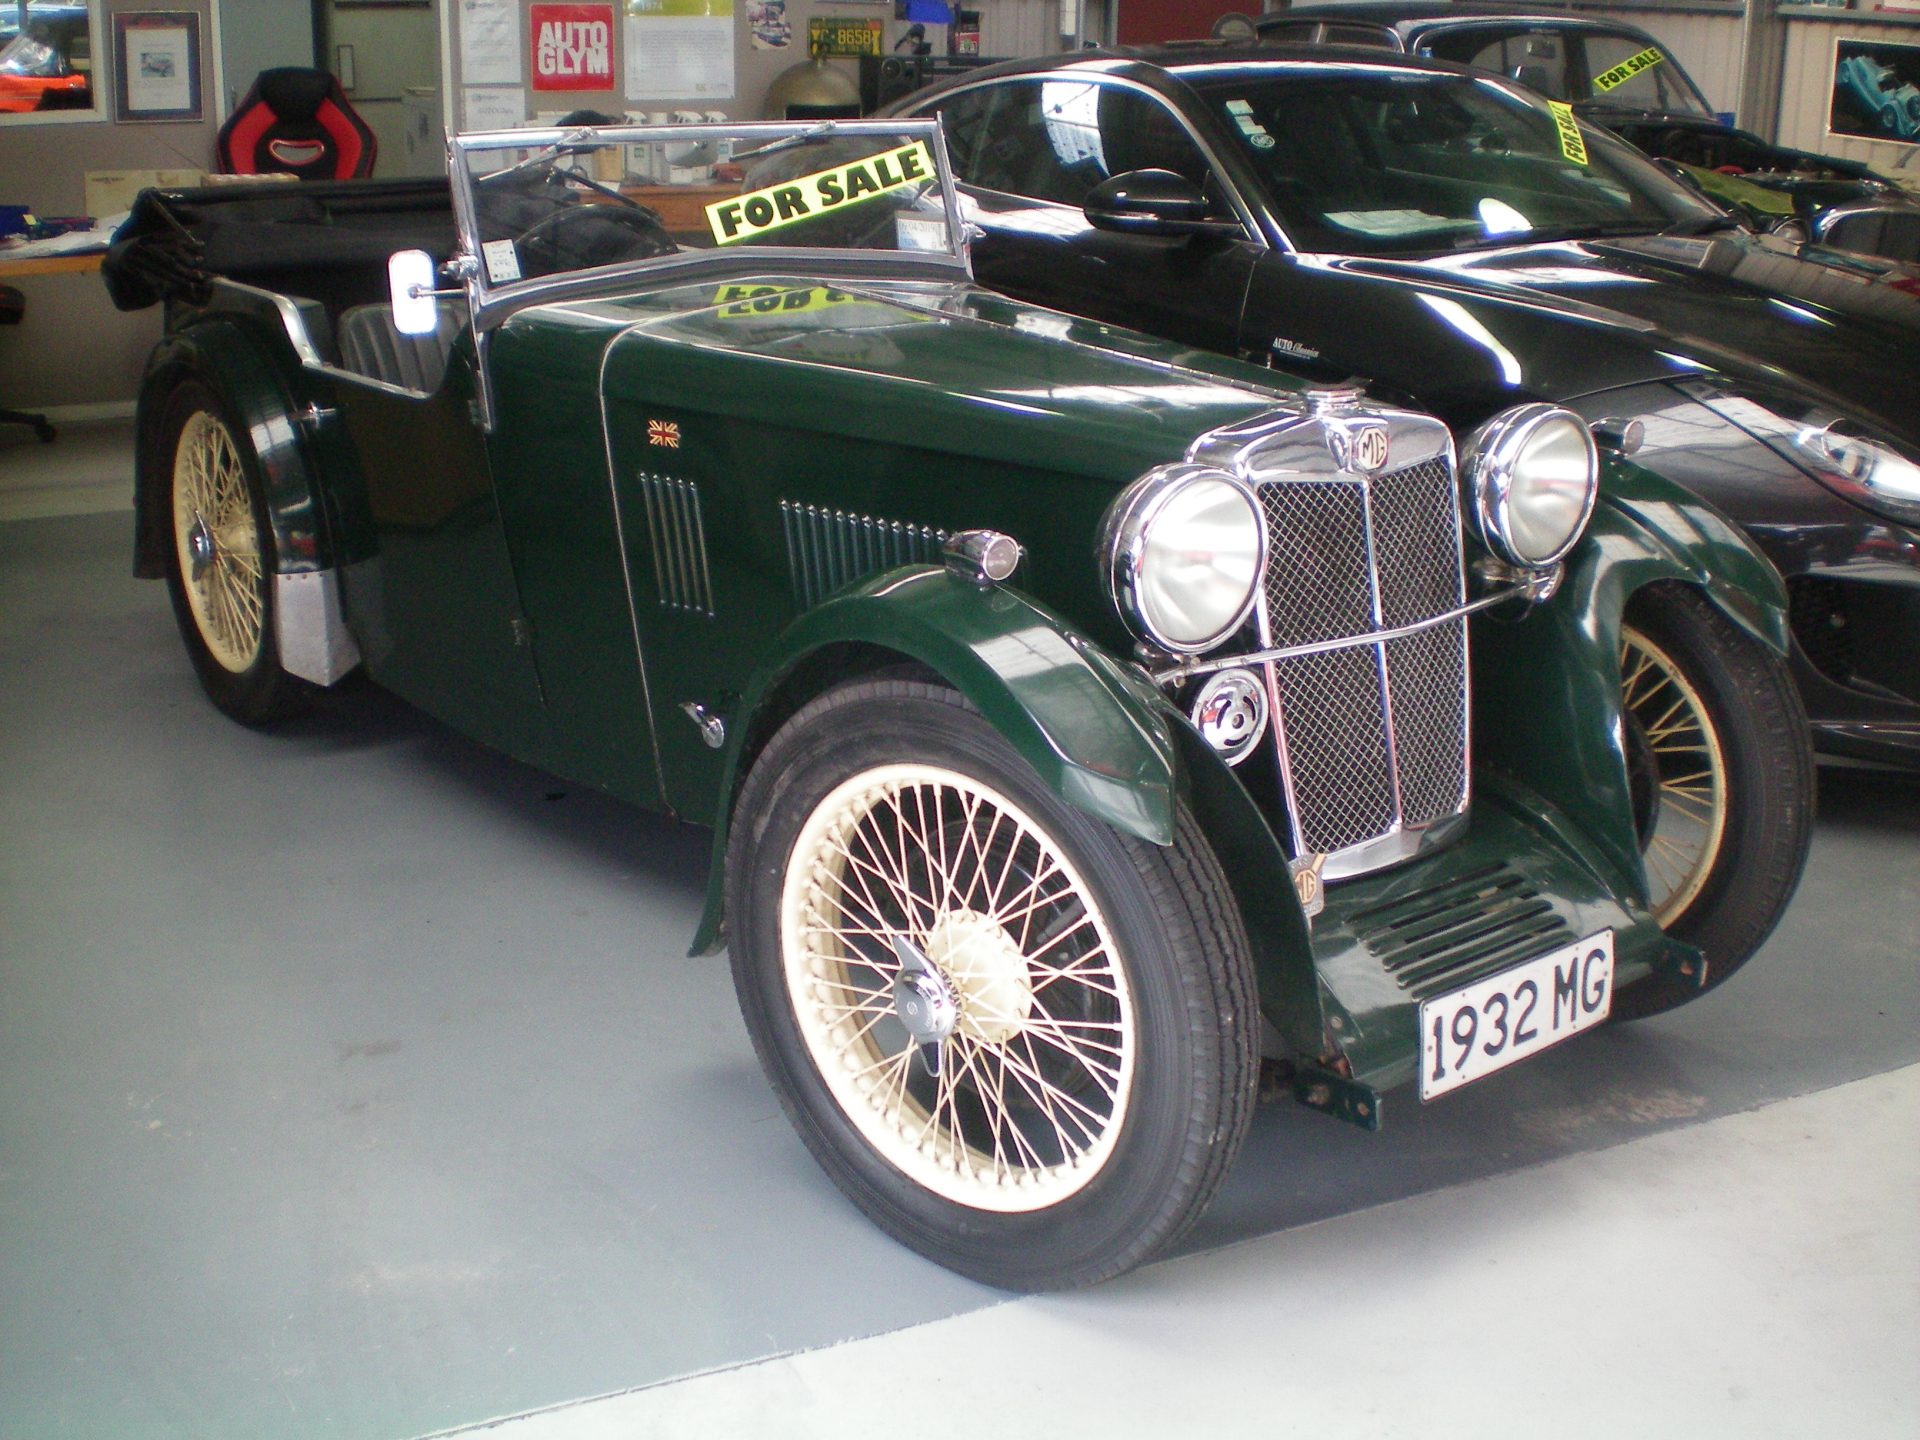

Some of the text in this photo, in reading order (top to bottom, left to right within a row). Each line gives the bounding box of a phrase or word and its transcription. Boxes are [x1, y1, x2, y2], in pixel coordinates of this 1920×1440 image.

[538, 20, 608, 49] AUTO
[537, 47, 609, 75] GLYM
[1598, 49, 1662, 88] FOR SALE
[1562, 132, 1585, 162] FOR
[716, 148, 926, 238] FOR SALE
[1272, 337, 1294, 351] AUTO
[1362, 431, 1386, 465] MG
[1432, 948, 1607, 1082] 1932 MG
